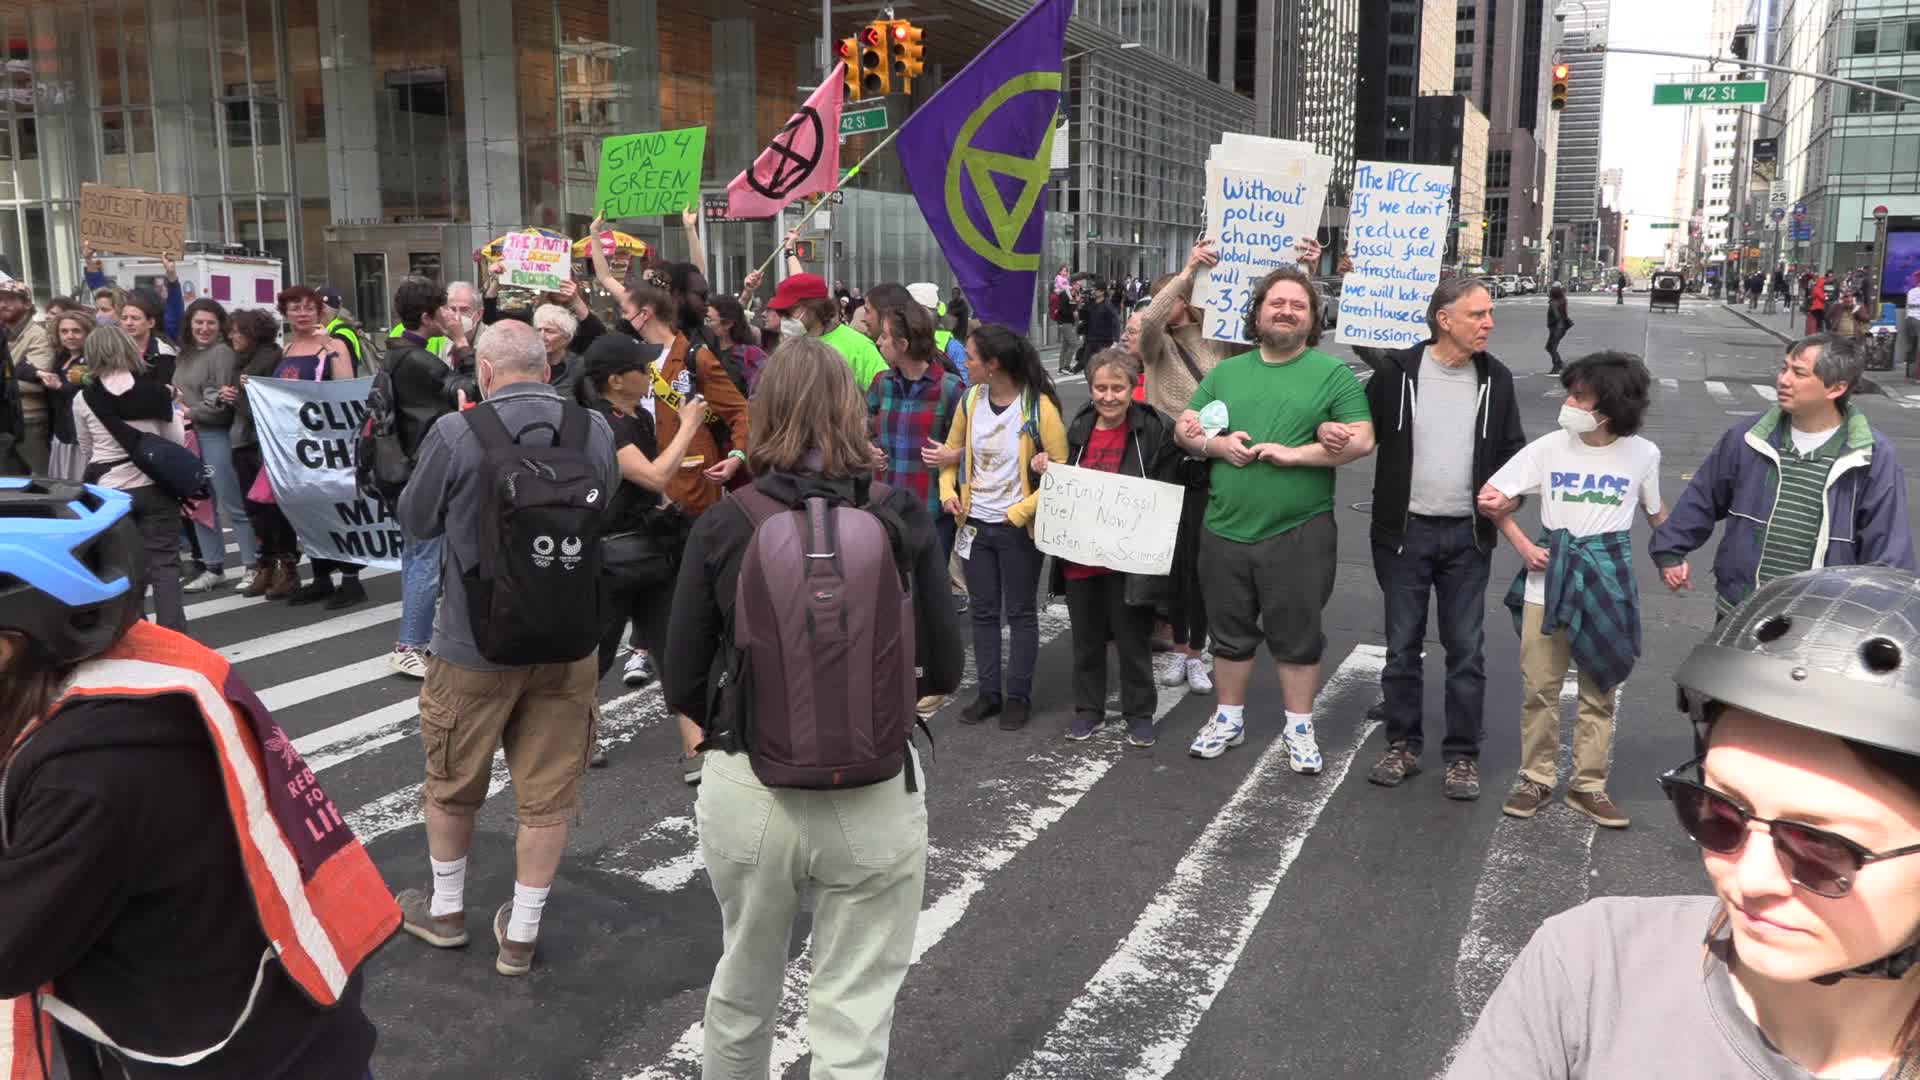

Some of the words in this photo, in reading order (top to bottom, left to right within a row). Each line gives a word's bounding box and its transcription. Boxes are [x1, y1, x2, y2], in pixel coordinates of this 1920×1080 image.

[1683, 87, 1694, 101] W
[1698, 87, 1716, 100] 42
[1721, 86, 1736, 100] St
[842, 117, 854, 129] 42
[856, 116, 866, 128] St
[608, 134, 666, 170] STAND
[675, 133, 692, 159] 4
[638, 156, 653, 172] A
[609, 169, 690, 196] GREEN
[1223, 176, 1306, 205] Without
[1356, 165, 1383, 189] The
[1387, 167, 1422, 193] IPCC
[1424, 180, 1452, 200] says
[604, 190, 689, 219] FUTURE
[1351, 192, 1370, 217] If
[1379, 200, 1401, 214] we
[1406, 200, 1445, 216] don't
[1771, 193, 1787, 202] 25
[1223, 202, 1285, 228] policy
[143, 226, 183, 251] LESS
[1221, 224, 1294, 252] change
[1355, 219, 1431, 240] reduce
[1349, 241, 1393, 258] fossil
[1402, 240, 1436, 261] fuel
[1210, 267, 1239, 286] will
[1354, 260, 1437, 283] nfrastructure
[1344, 284, 1366, 297] we
[1370, 284, 1394, 299] will
[1344, 324, 1421, 344] emissions
[1043, 472, 1104, 501] Defund
[1114, 486, 1157, 513] Fossil
[1551, 472, 1630, 505] PEACE
[1043, 497, 1076, 521] Fuel
[1041, 522, 1080, 550] Listen
